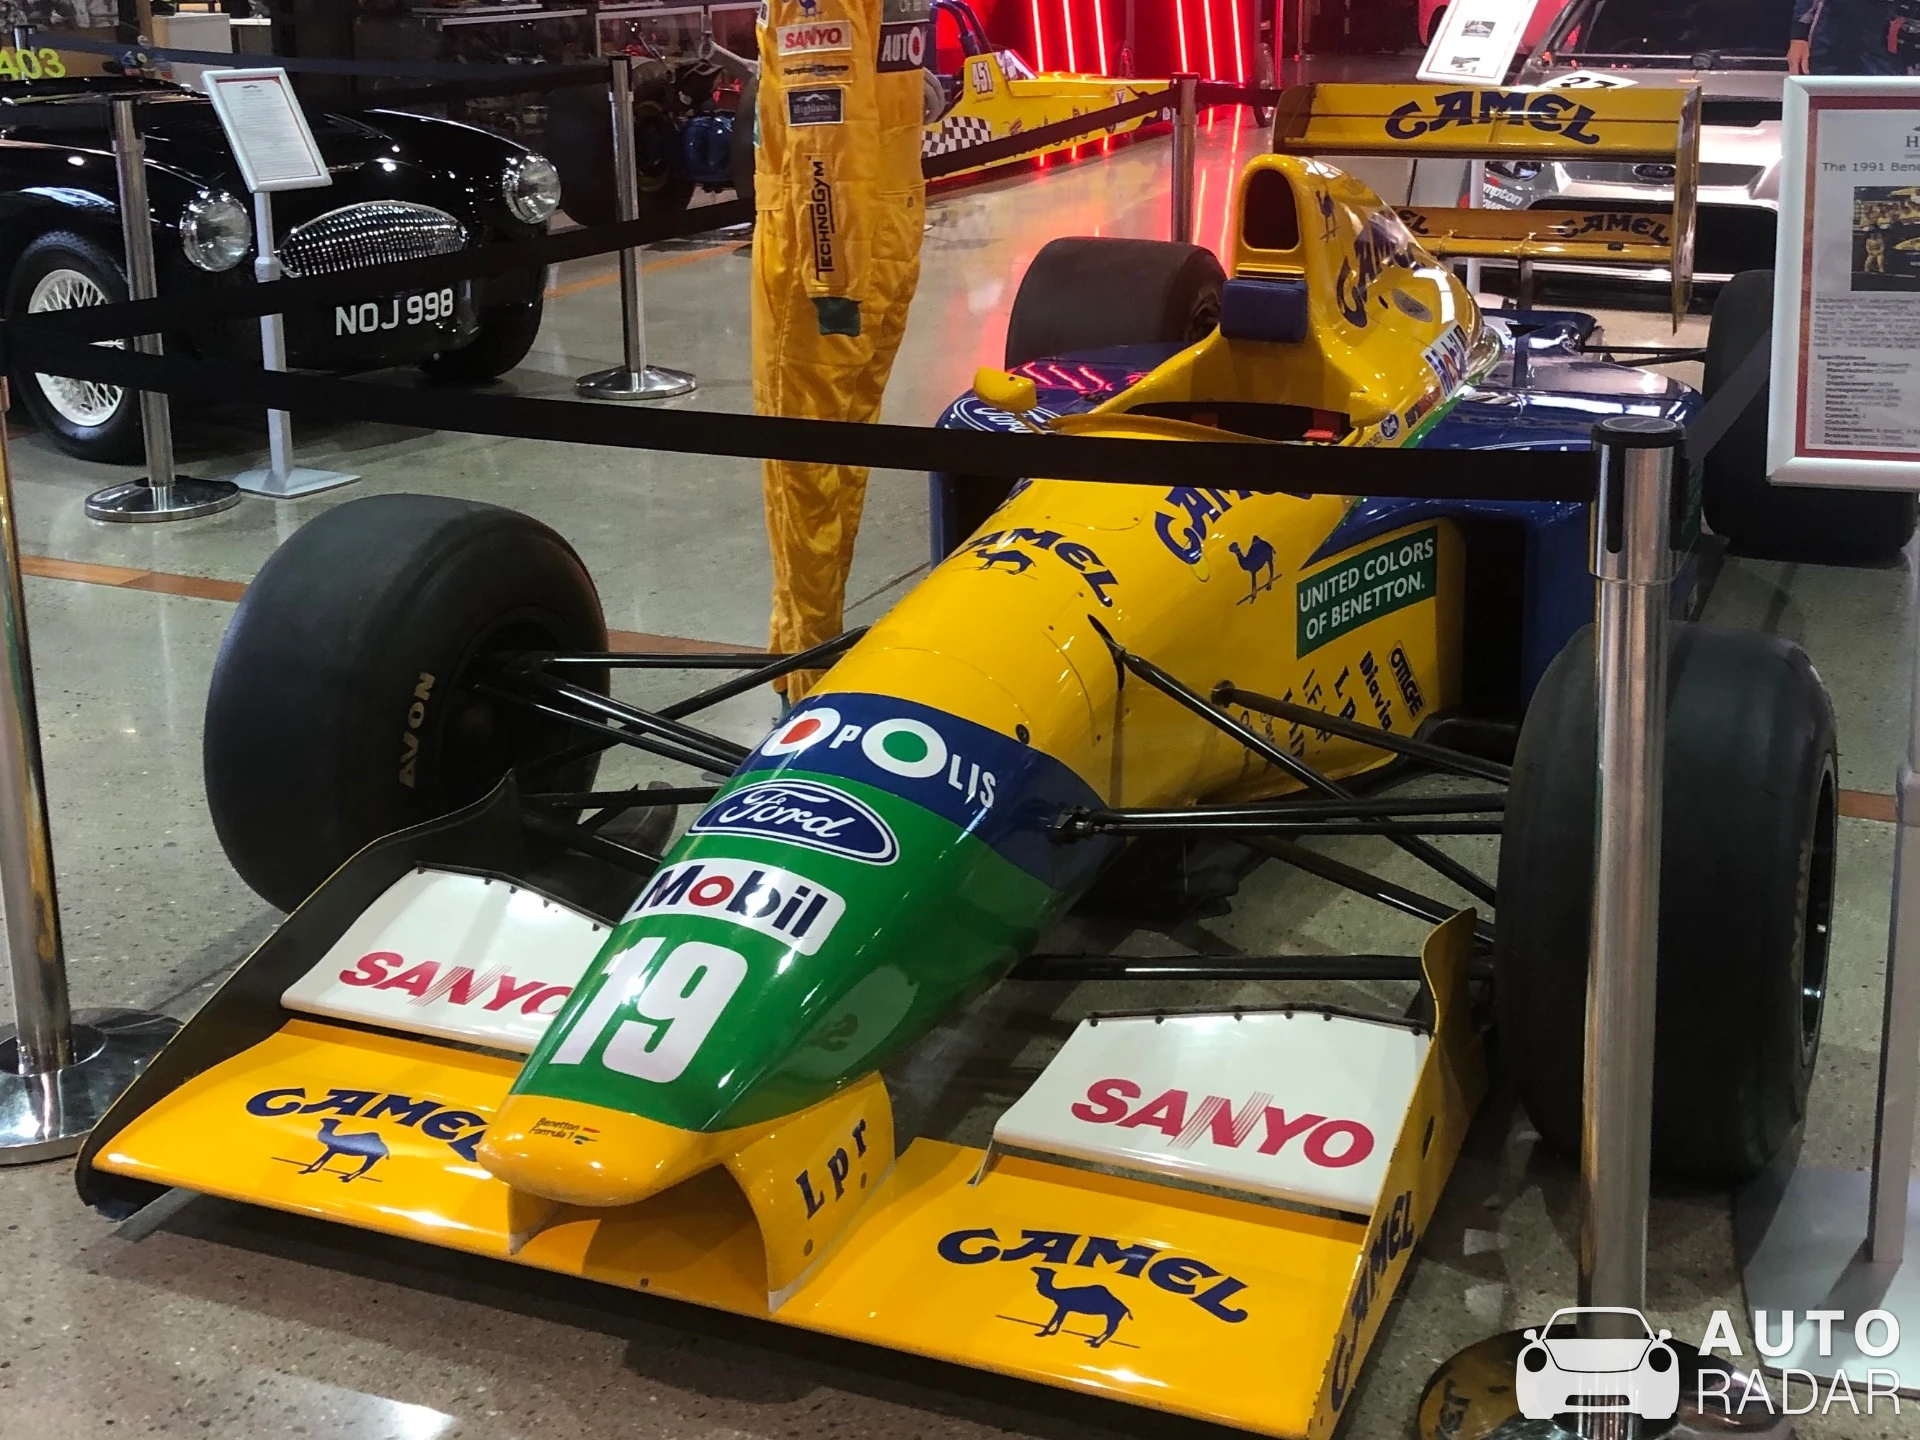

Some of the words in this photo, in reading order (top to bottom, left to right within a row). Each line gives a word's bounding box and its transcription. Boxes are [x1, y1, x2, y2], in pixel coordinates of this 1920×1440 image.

[785, 27, 842, 49] SANYO
[971, 61, 994, 94] 451
[1385, 91, 1600, 145] CAMEL
[1483, 182, 1523, 206] mpton
[1822, 162, 1846, 172] The
[1852, 162, 1885, 172] 1991
[1557, 213, 1669, 244] CAMEL
[335, 299, 399, 336] NOJ
[407, 288, 453, 325] 998
[1154, 486, 1312, 565] CAM
[948, 527, 1119, 608] AMEL
[1300, 567, 1360, 613] UNITED
[1363, 538, 1434, 581] COLORS
[1306, 612, 1328, 640] OF
[1331, 571, 1426, 628] BENETTON.
[399, 671, 436, 788] AVON
[718, 788, 855, 838] Ford
[633, 863, 829, 939] Mobil
[550, 936, 748, 1083] 19
[528, 1126, 566, 1139] Formula
[566, 1131, 575, 1140] 1
[535, 1117, 580, 1131] Benetton
[1071, 1078, 1375, 1168] SANYO
[937, 1227, 1249, 1324] CAMEL
[1331, 1190, 1415, 1412] CAMEL
